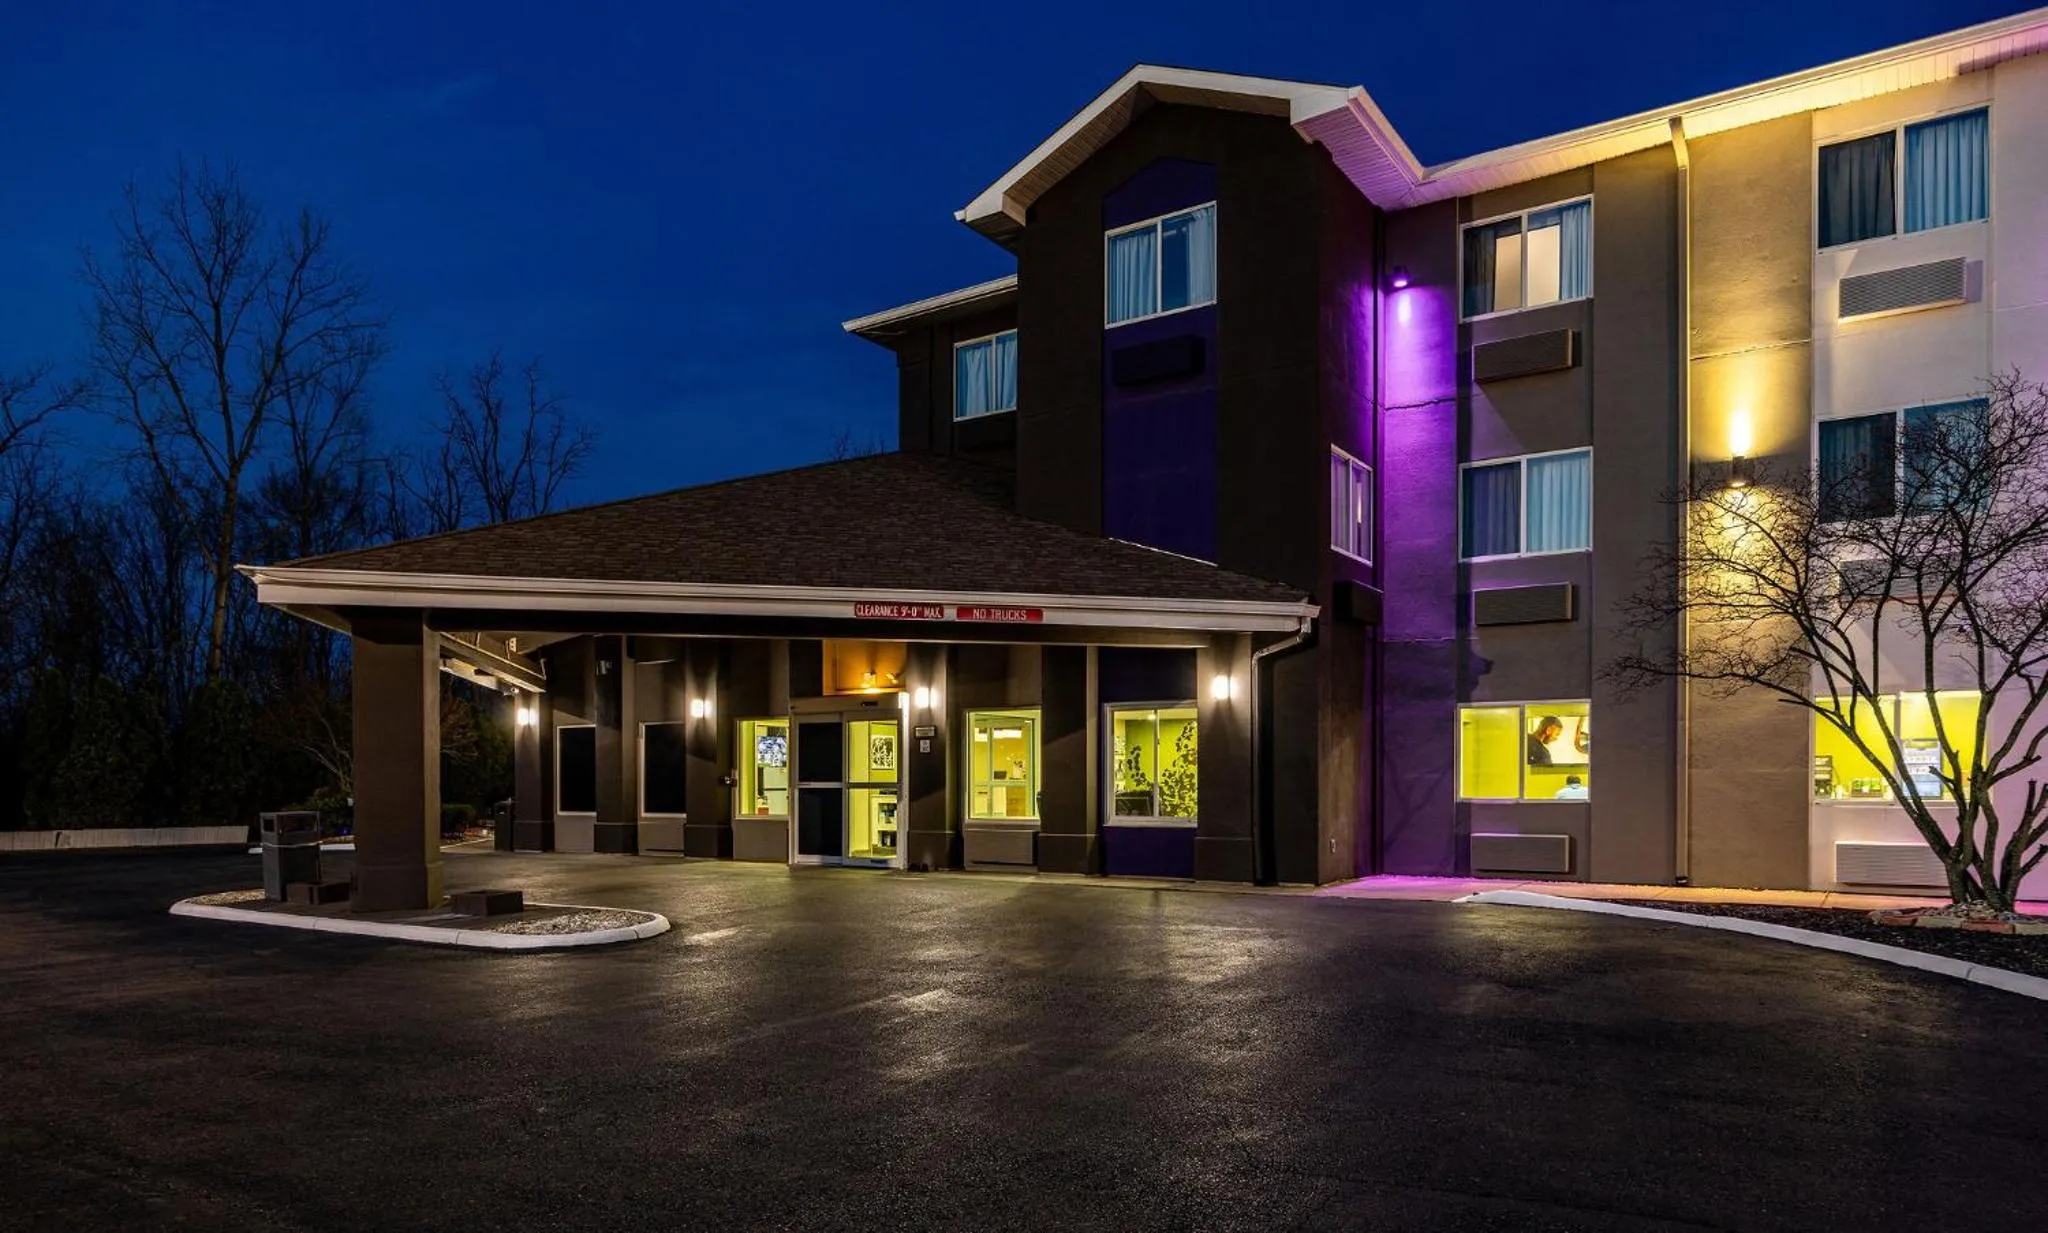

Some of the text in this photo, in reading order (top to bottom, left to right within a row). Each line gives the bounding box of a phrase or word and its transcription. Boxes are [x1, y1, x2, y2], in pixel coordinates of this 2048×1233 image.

[856, 604, 899, 617] CLEARANCE
[973, 608, 1027, 621] NO TRUCKS
